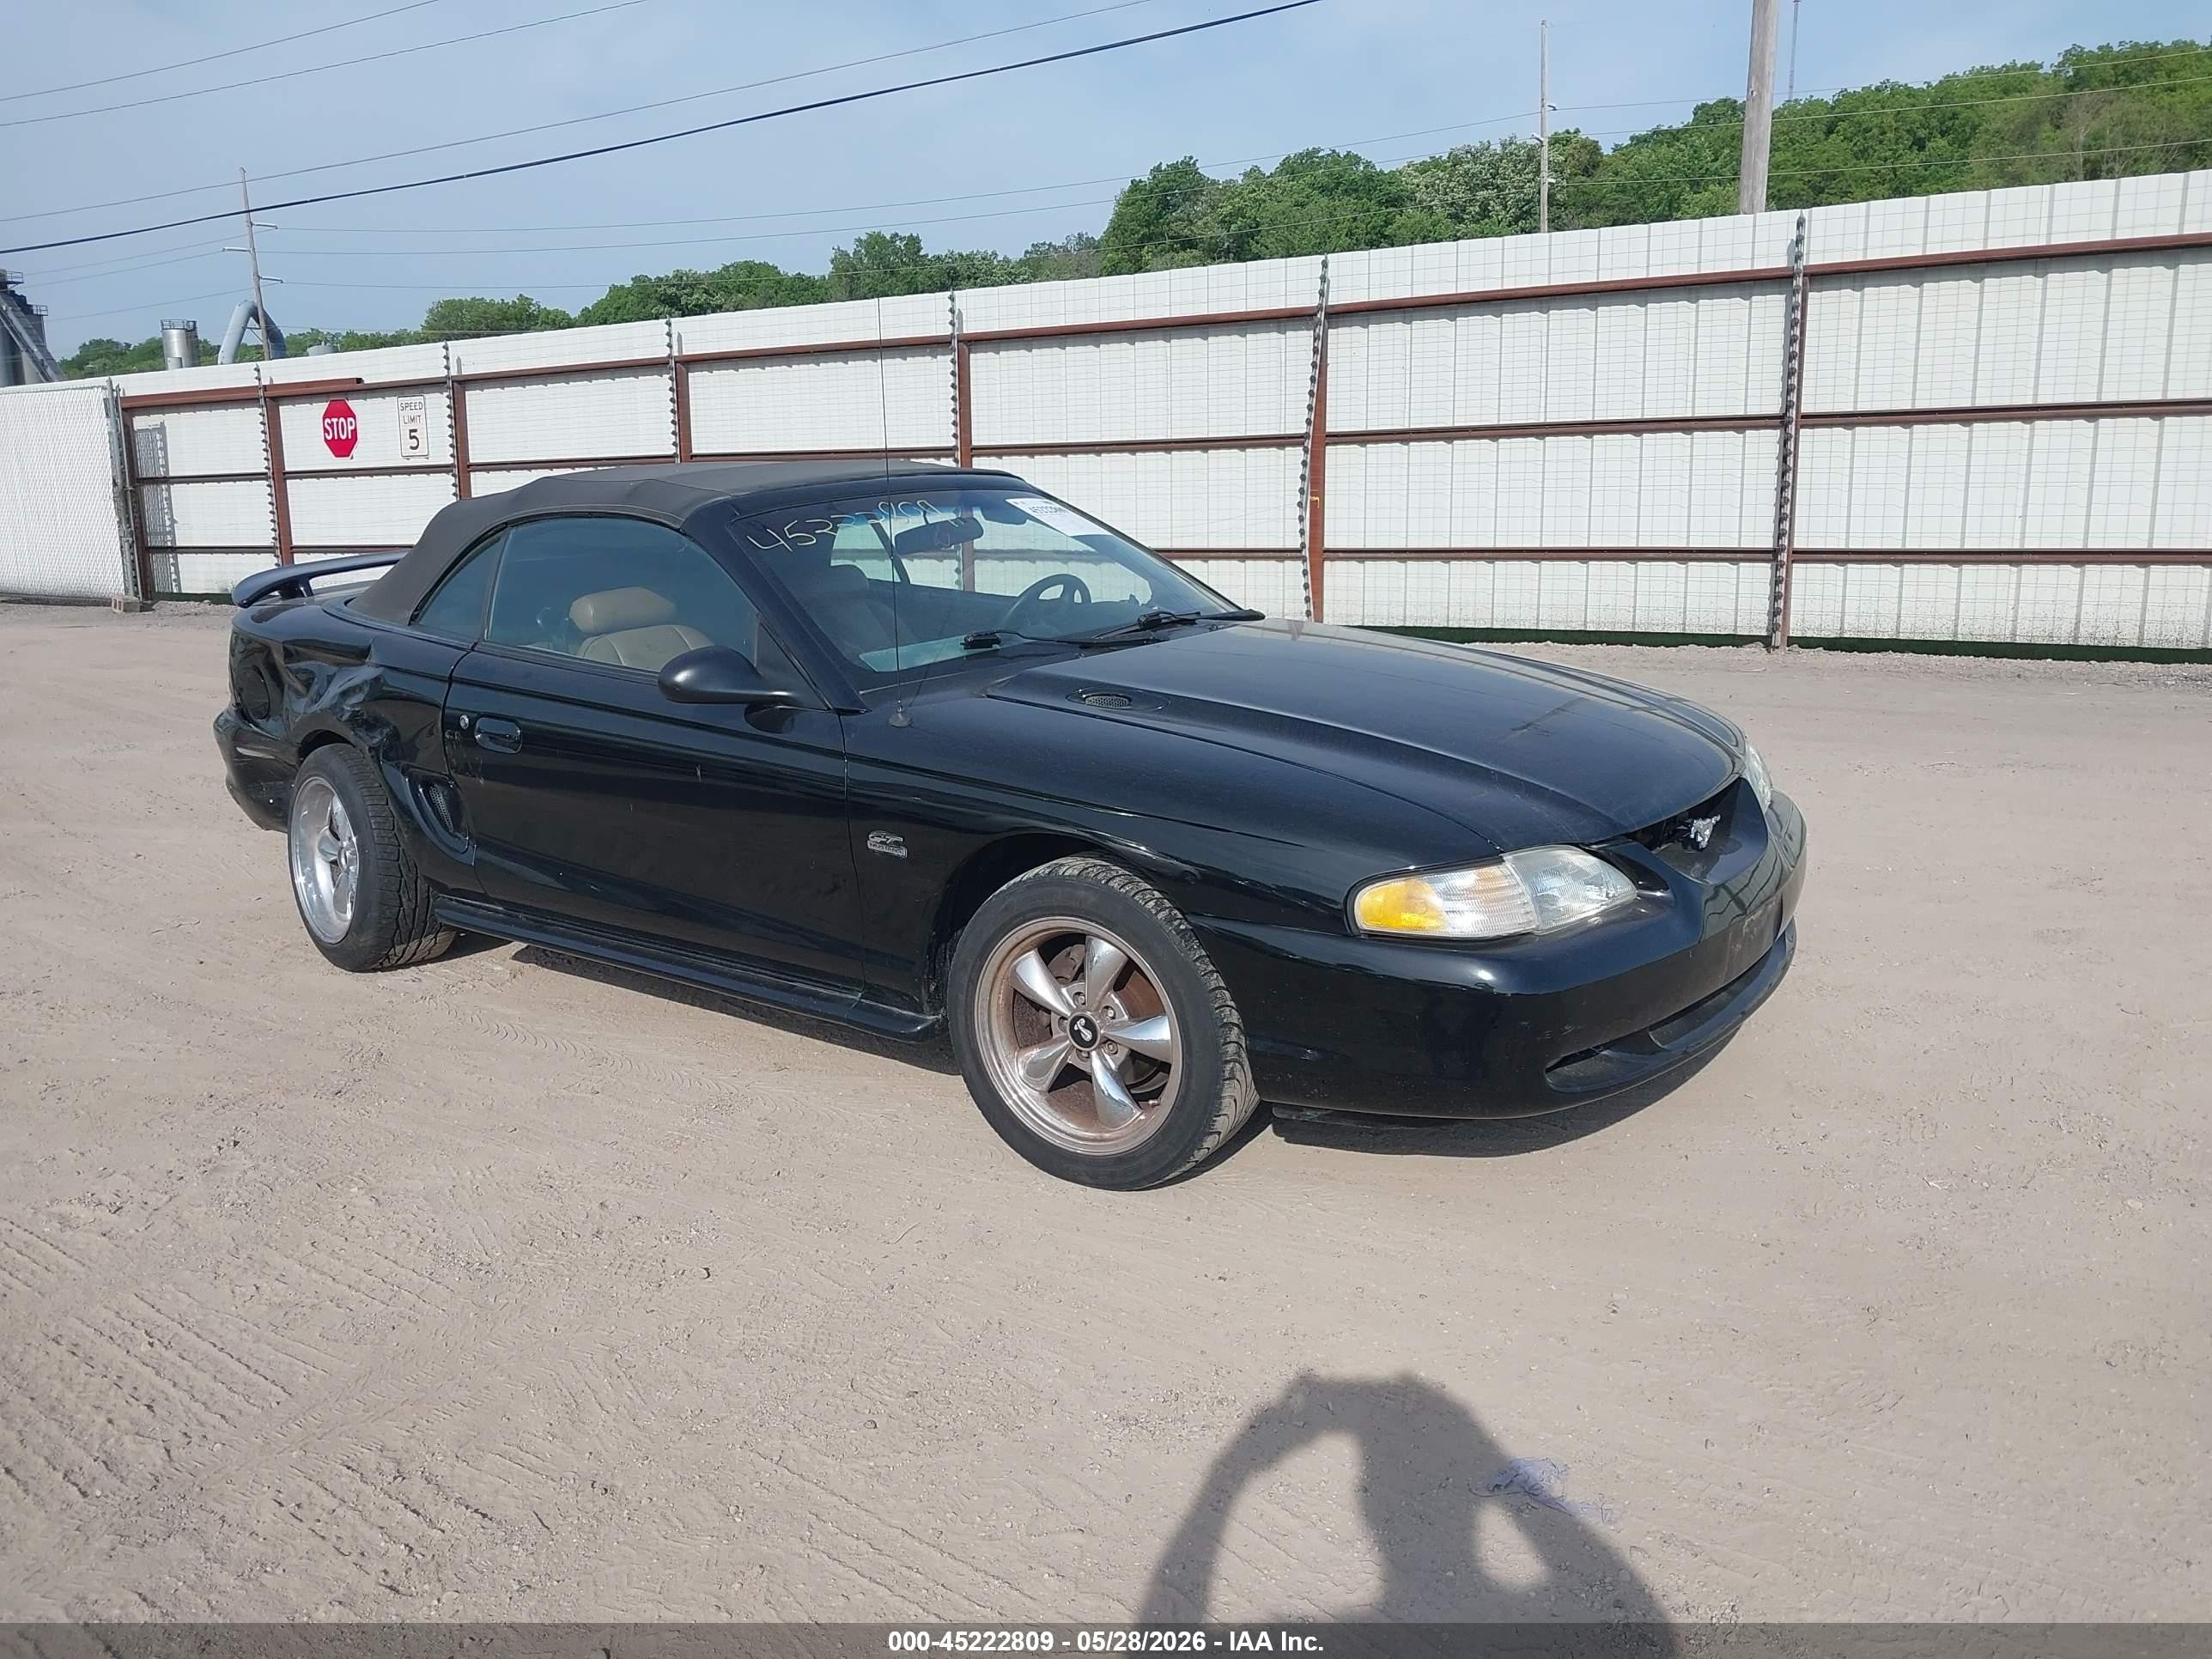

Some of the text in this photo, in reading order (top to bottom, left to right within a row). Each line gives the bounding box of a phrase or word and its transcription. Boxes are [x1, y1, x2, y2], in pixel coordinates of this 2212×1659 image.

[400, 402, 423, 410] SPEED
[403, 415, 422, 424] LIMIT
[324, 417, 356, 441] STOP
[409, 428, 420, 450] 5
